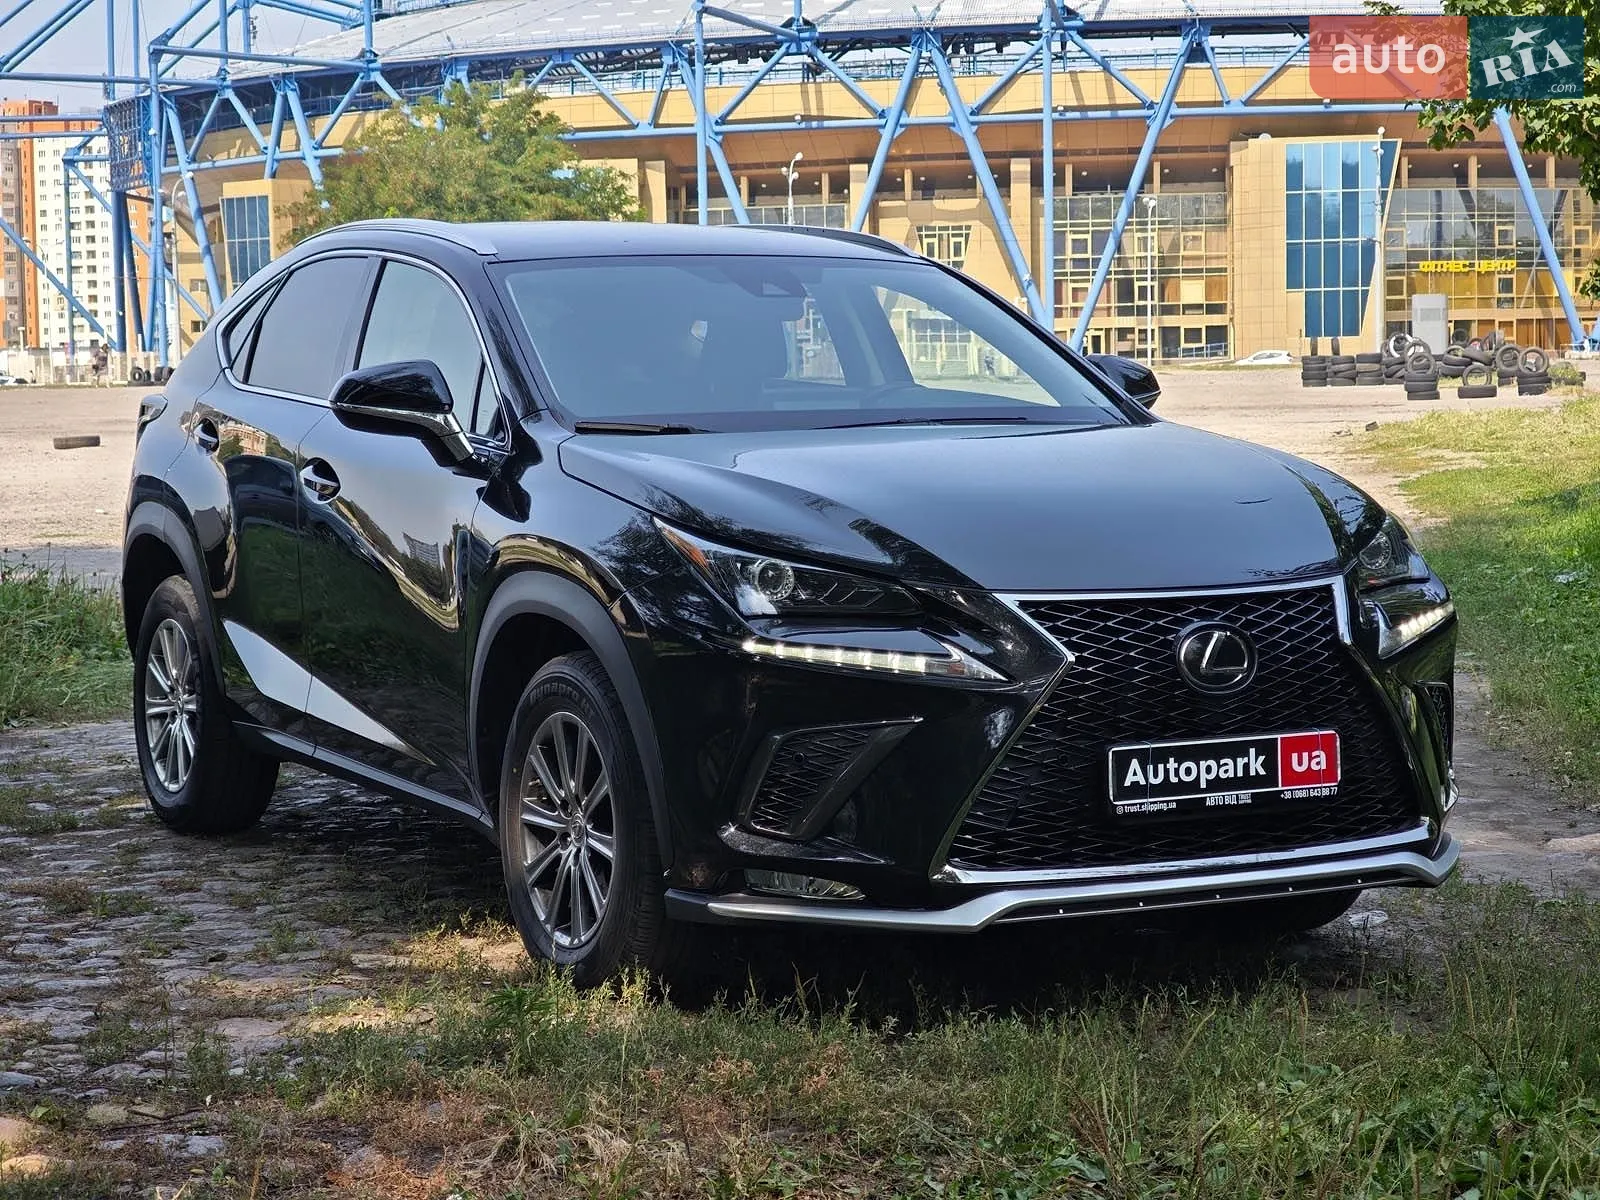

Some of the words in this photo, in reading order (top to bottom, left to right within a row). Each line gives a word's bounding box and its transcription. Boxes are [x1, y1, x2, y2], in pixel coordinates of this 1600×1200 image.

[1123, 747, 1267, 789] Autopark
[1291, 750, 1327, 773] ua
[1330, 786, 1338, 795] 77
